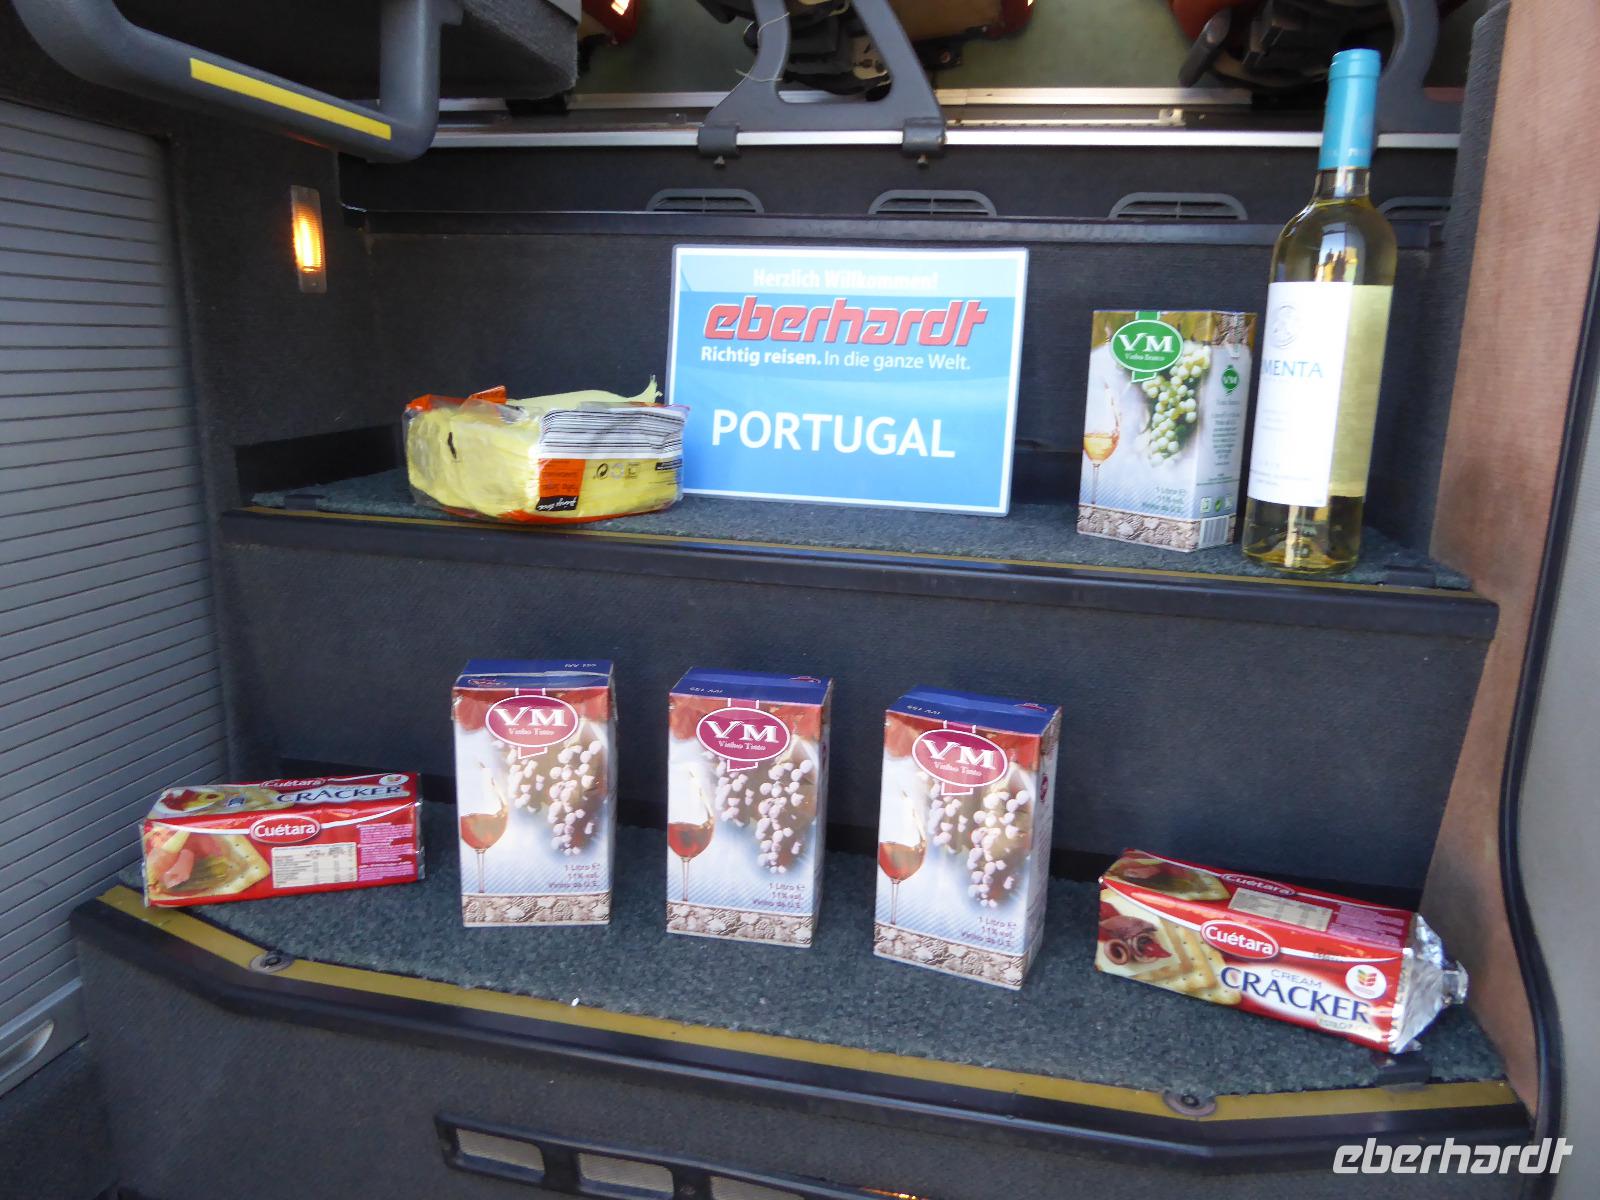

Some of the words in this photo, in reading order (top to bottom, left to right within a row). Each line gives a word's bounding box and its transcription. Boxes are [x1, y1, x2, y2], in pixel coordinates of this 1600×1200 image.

[753, 268, 821, 289] Herzlich
[703, 295, 989, 347] eberhardt
[1117, 332, 1175, 353] VM
[700, 346, 761, 367] Richtig
[763, 348, 822, 365] reisen.
[824, 351, 841, 366] In
[843, 351, 871, 367] die
[873, 354, 924, 372] ganze
[927, 353, 971, 371] Welt.
[712, 409, 956, 458] PORTUGAL
[493, 706, 569, 727] VM
[704, 720, 779, 743] VM
[921, 739, 997, 770] VM
[276, 786, 401, 803] CRACKER
[253, 822, 317, 838] Cuétara
[1224, 873, 1292, 896] Cuétara
[1204, 925, 1274, 956] Cuétara
[1270, 969, 1322, 988] CREAM
[1221, 966, 1370, 1024] CRACKER
